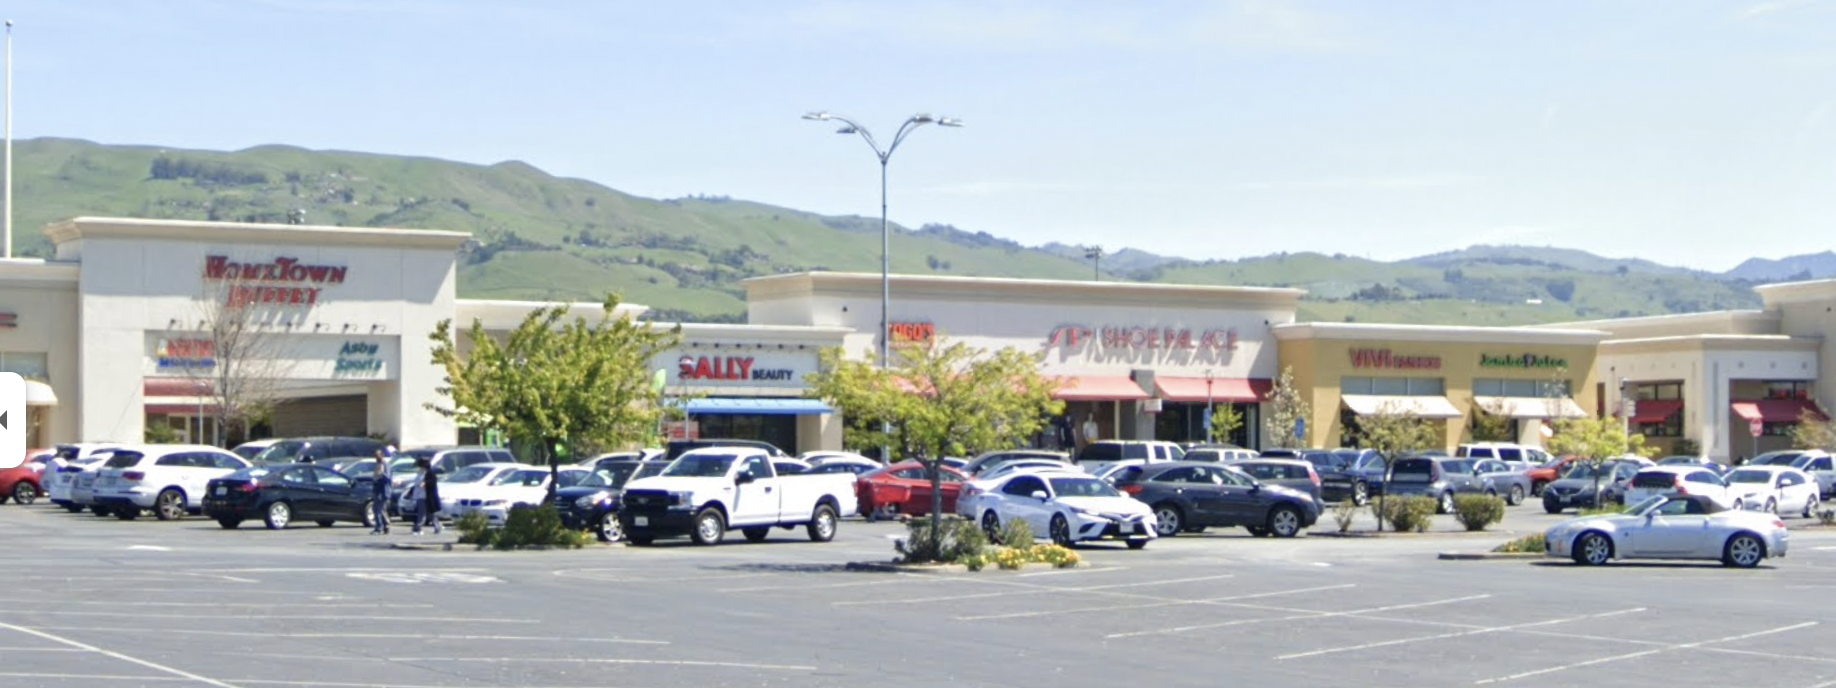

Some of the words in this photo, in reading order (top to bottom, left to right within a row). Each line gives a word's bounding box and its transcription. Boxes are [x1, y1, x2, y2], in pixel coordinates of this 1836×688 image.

[1101, 326, 1161, 349] SHOE
[1163, 327, 1239, 350] PALACE
[678, 355, 754, 380] SALLY
[752, 368, 793, 381] BEAUTY
